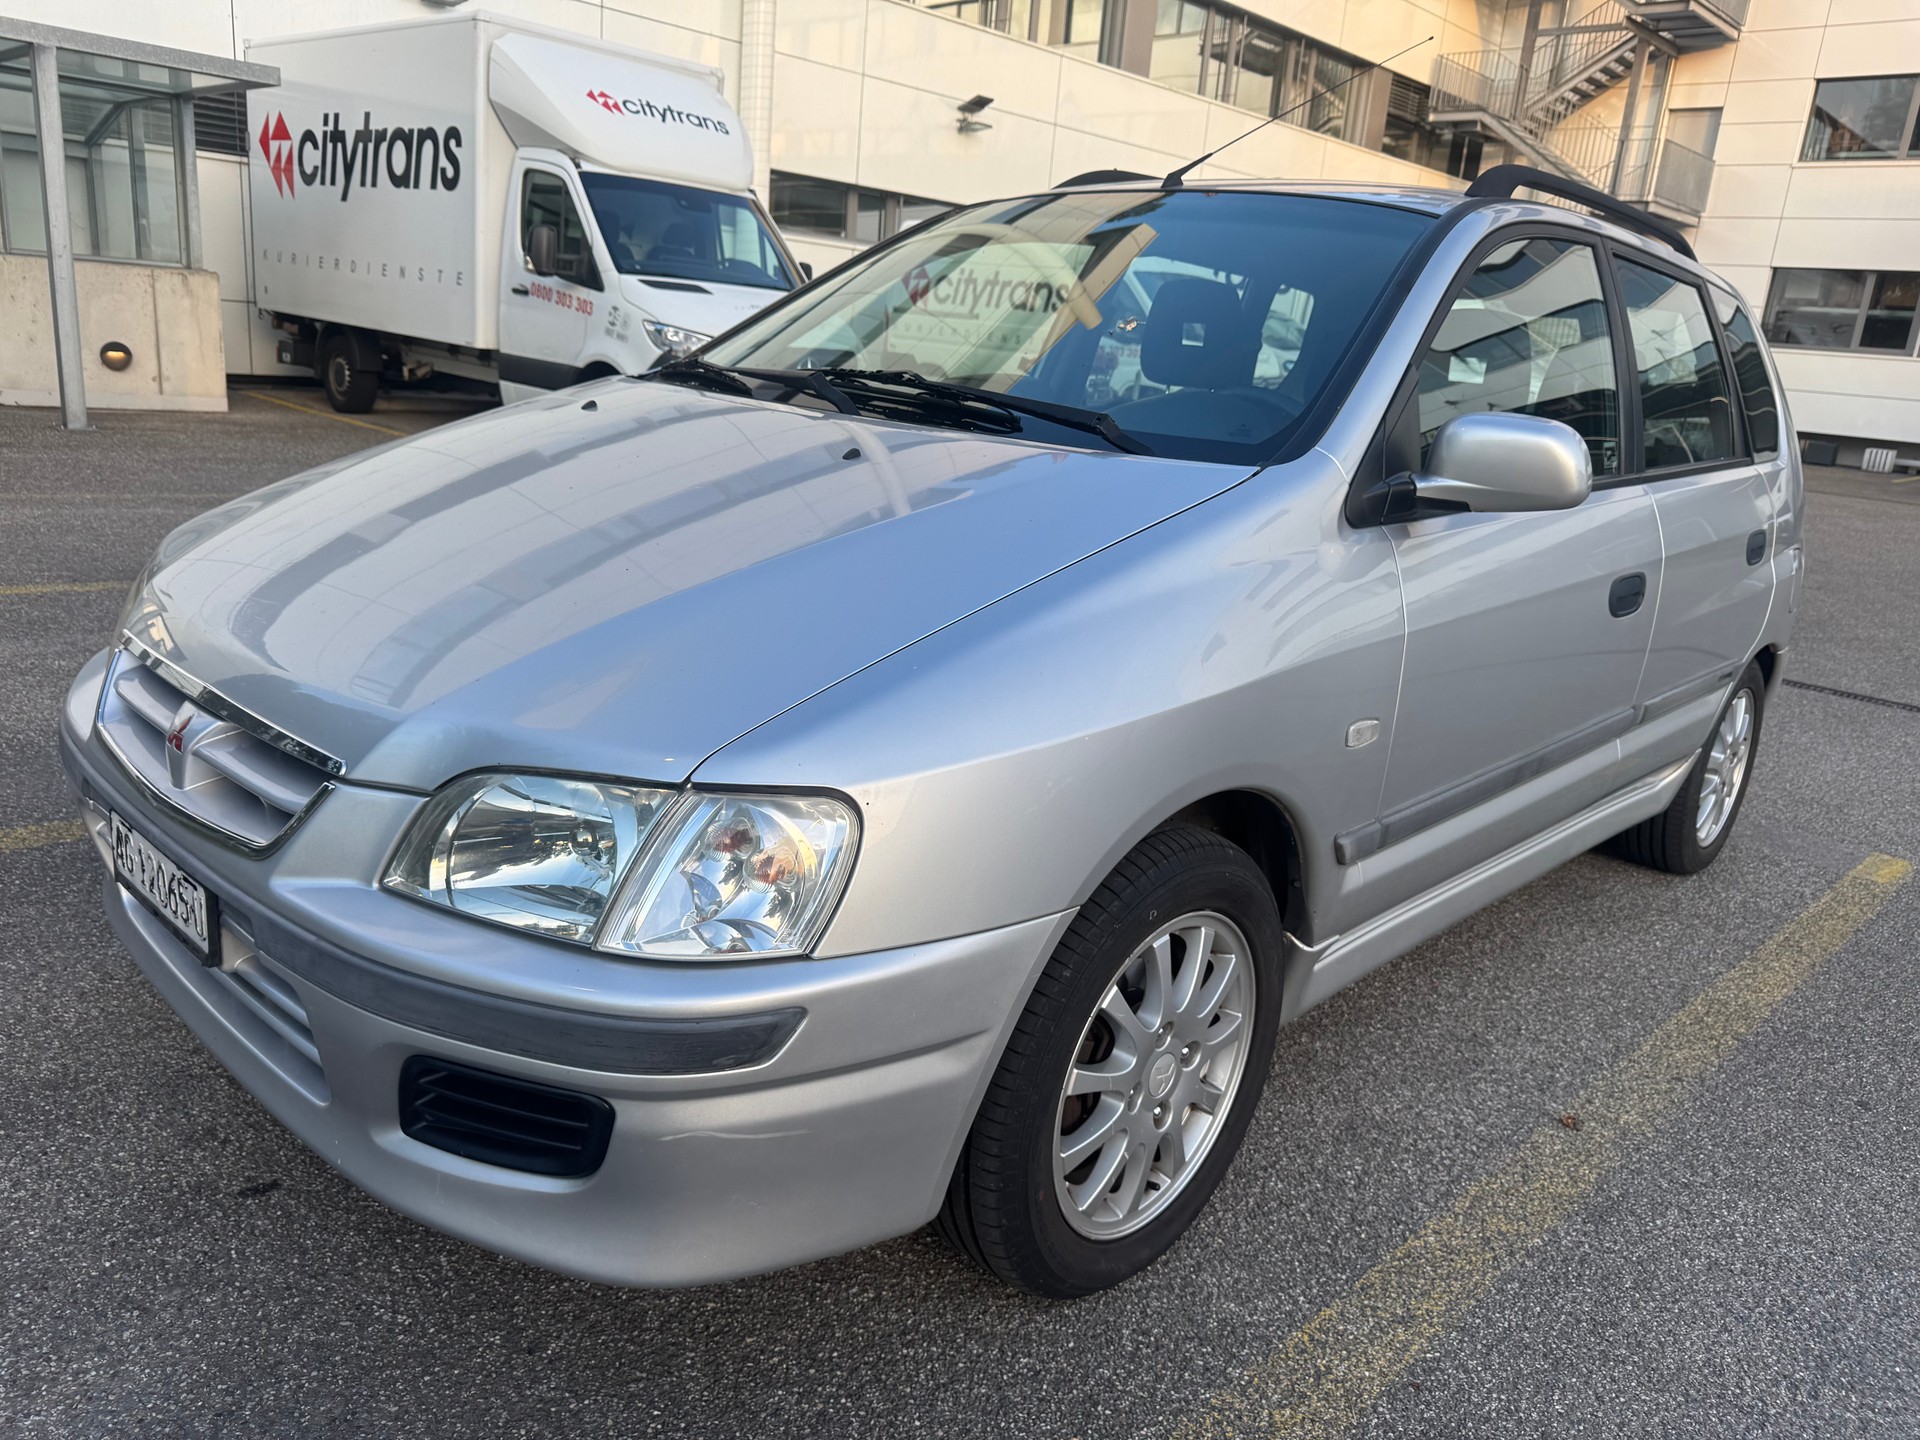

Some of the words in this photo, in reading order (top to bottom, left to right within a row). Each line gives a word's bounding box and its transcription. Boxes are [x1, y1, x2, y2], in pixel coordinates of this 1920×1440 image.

[622, 98, 730, 136] citytrans
[297, 111, 463, 202] citytrans
[263, 249, 463, 287] KURIERDIENSTE
[530, 282, 553, 303] 0800
[555, 289, 573, 309] 303
[575, 296, 594, 316] 303
[933, 268, 1070, 315] citytrans
